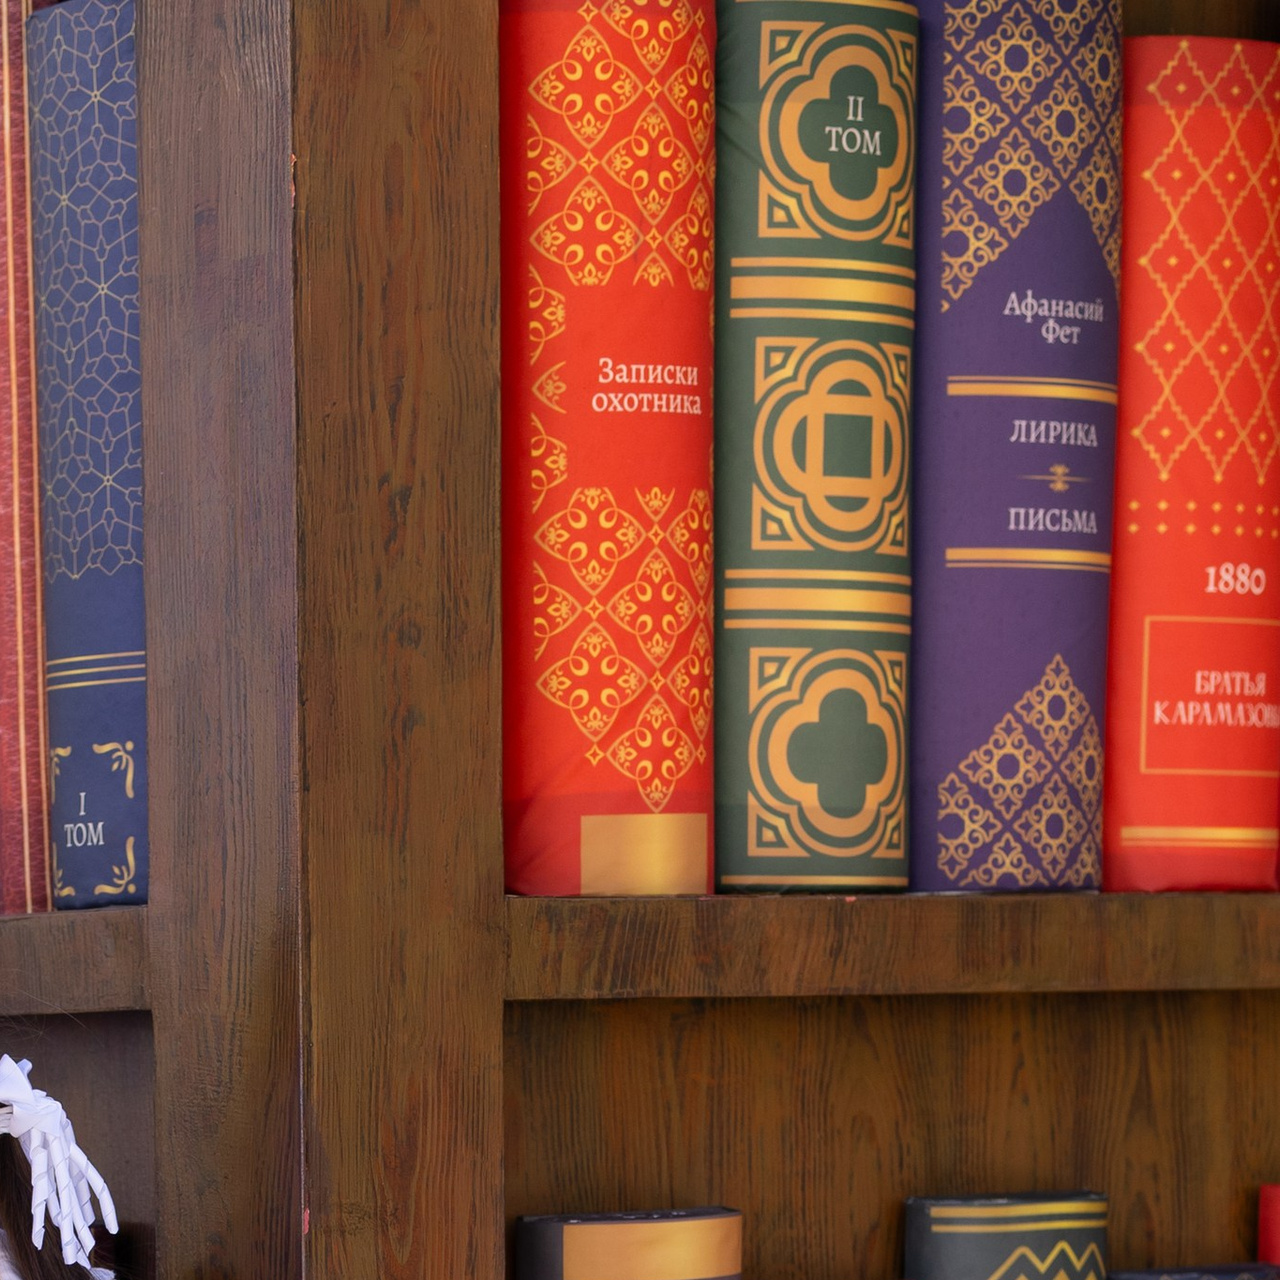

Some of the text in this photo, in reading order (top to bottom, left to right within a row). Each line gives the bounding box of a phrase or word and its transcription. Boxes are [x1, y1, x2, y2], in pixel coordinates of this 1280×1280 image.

[846, 95, 865, 121] II
[825, 126, 882, 156] ТОМ
[1003, 289, 1104, 323] Афанасий
[1041, 318, 1081, 344] Фет
[598, 357, 699, 386] Записки
[591, 392, 702, 415] охотника
[1009, 419, 1098, 447] ЛИРИКА
[1008, 507, 1098, 534] ПИСЬМА
[1205, 562, 1267, 596] 1880
[1195, 669, 1267, 697] БРАТЬЯ
[79, 791, 86, 816] I
[64, 821, 105, 848] ТОМ
